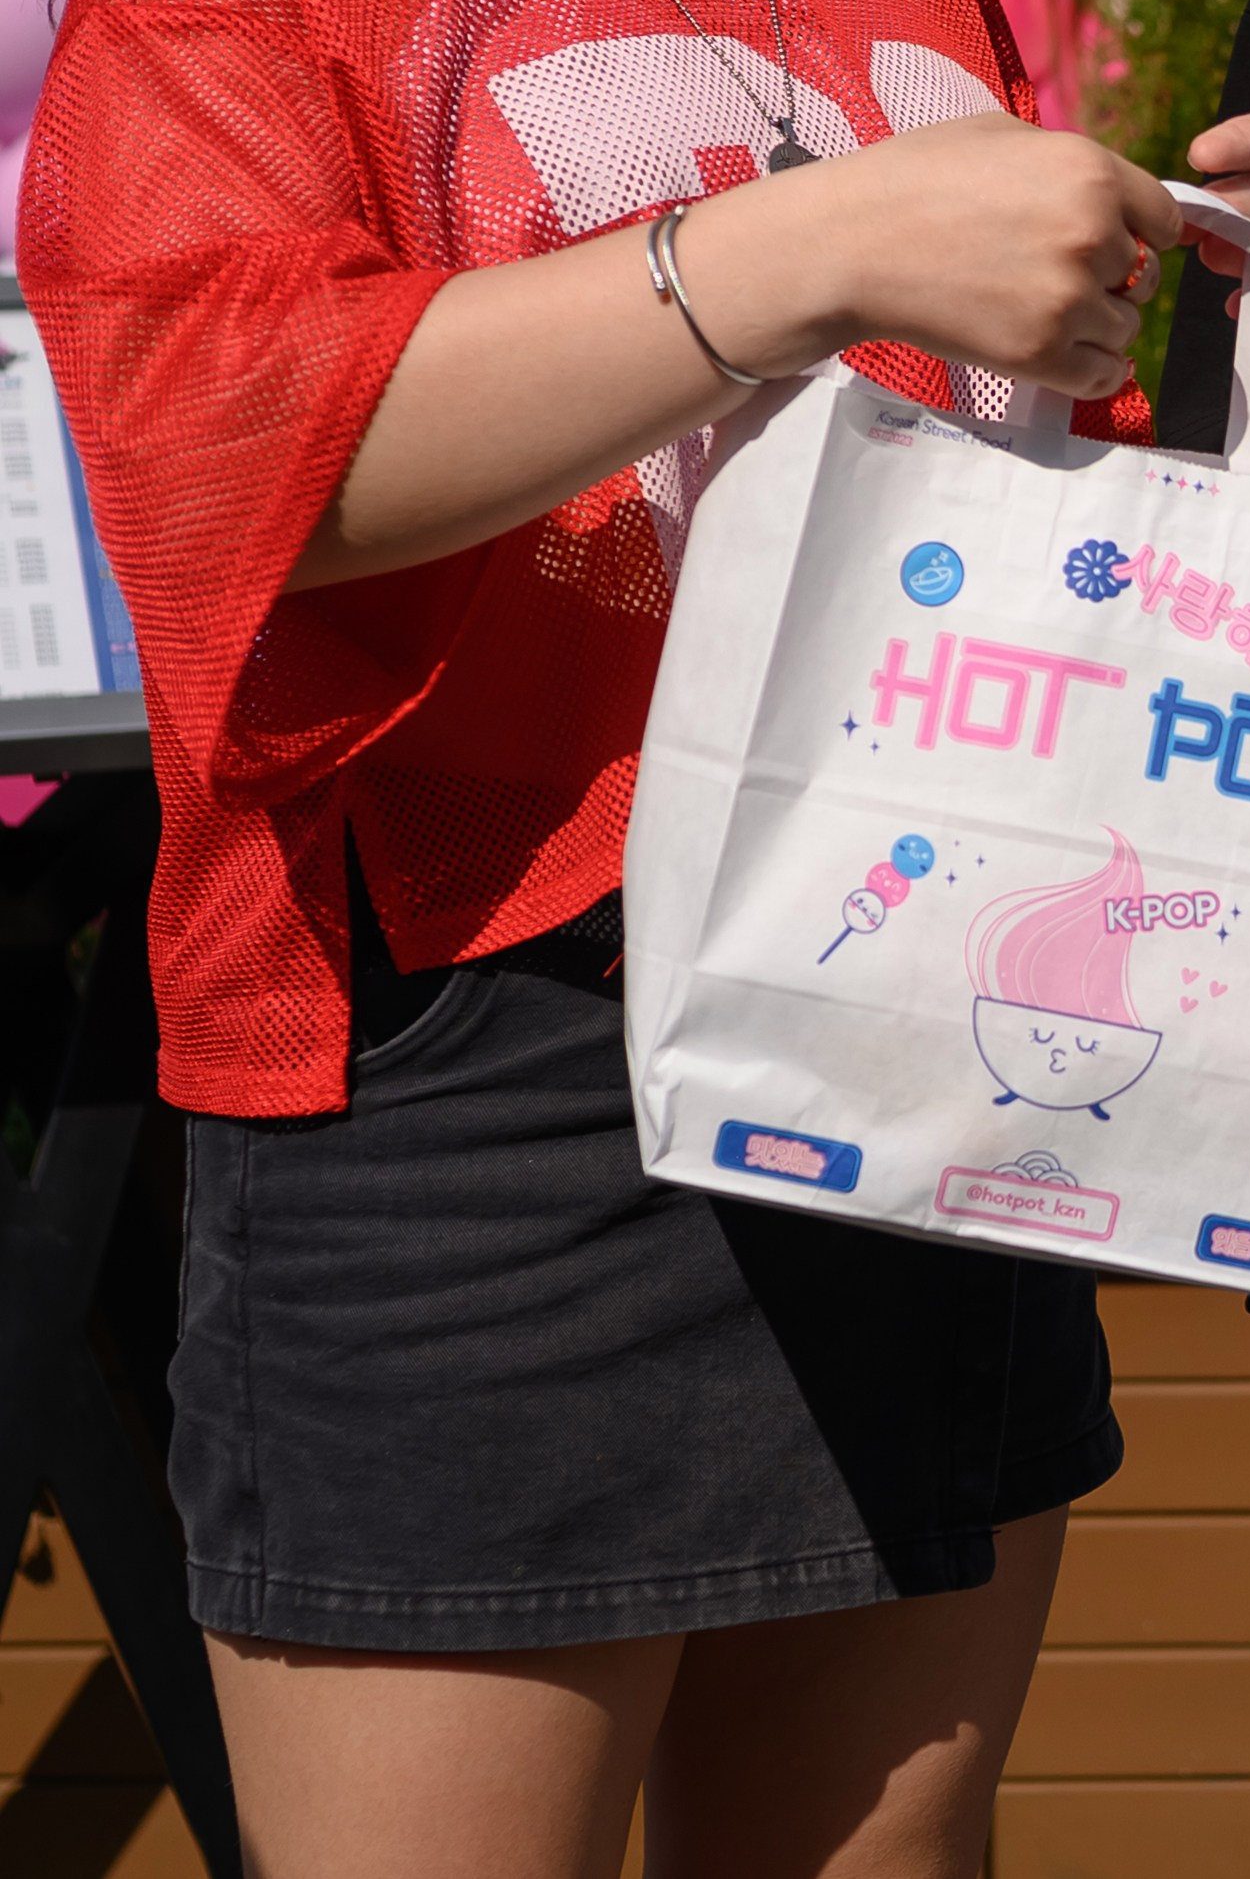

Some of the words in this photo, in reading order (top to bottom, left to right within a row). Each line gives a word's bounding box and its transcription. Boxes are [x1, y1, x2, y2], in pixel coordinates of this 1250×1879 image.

[875, 409, 920, 431] Korean
[921, 418, 967, 444] Street
[970, 429, 1013, 452] Food
[870, 631, 1128, 760] HOT
[1104, 890, 1221, 935] K-POP
[966, 1183, 1086, 1220] @hotpot_kzn
